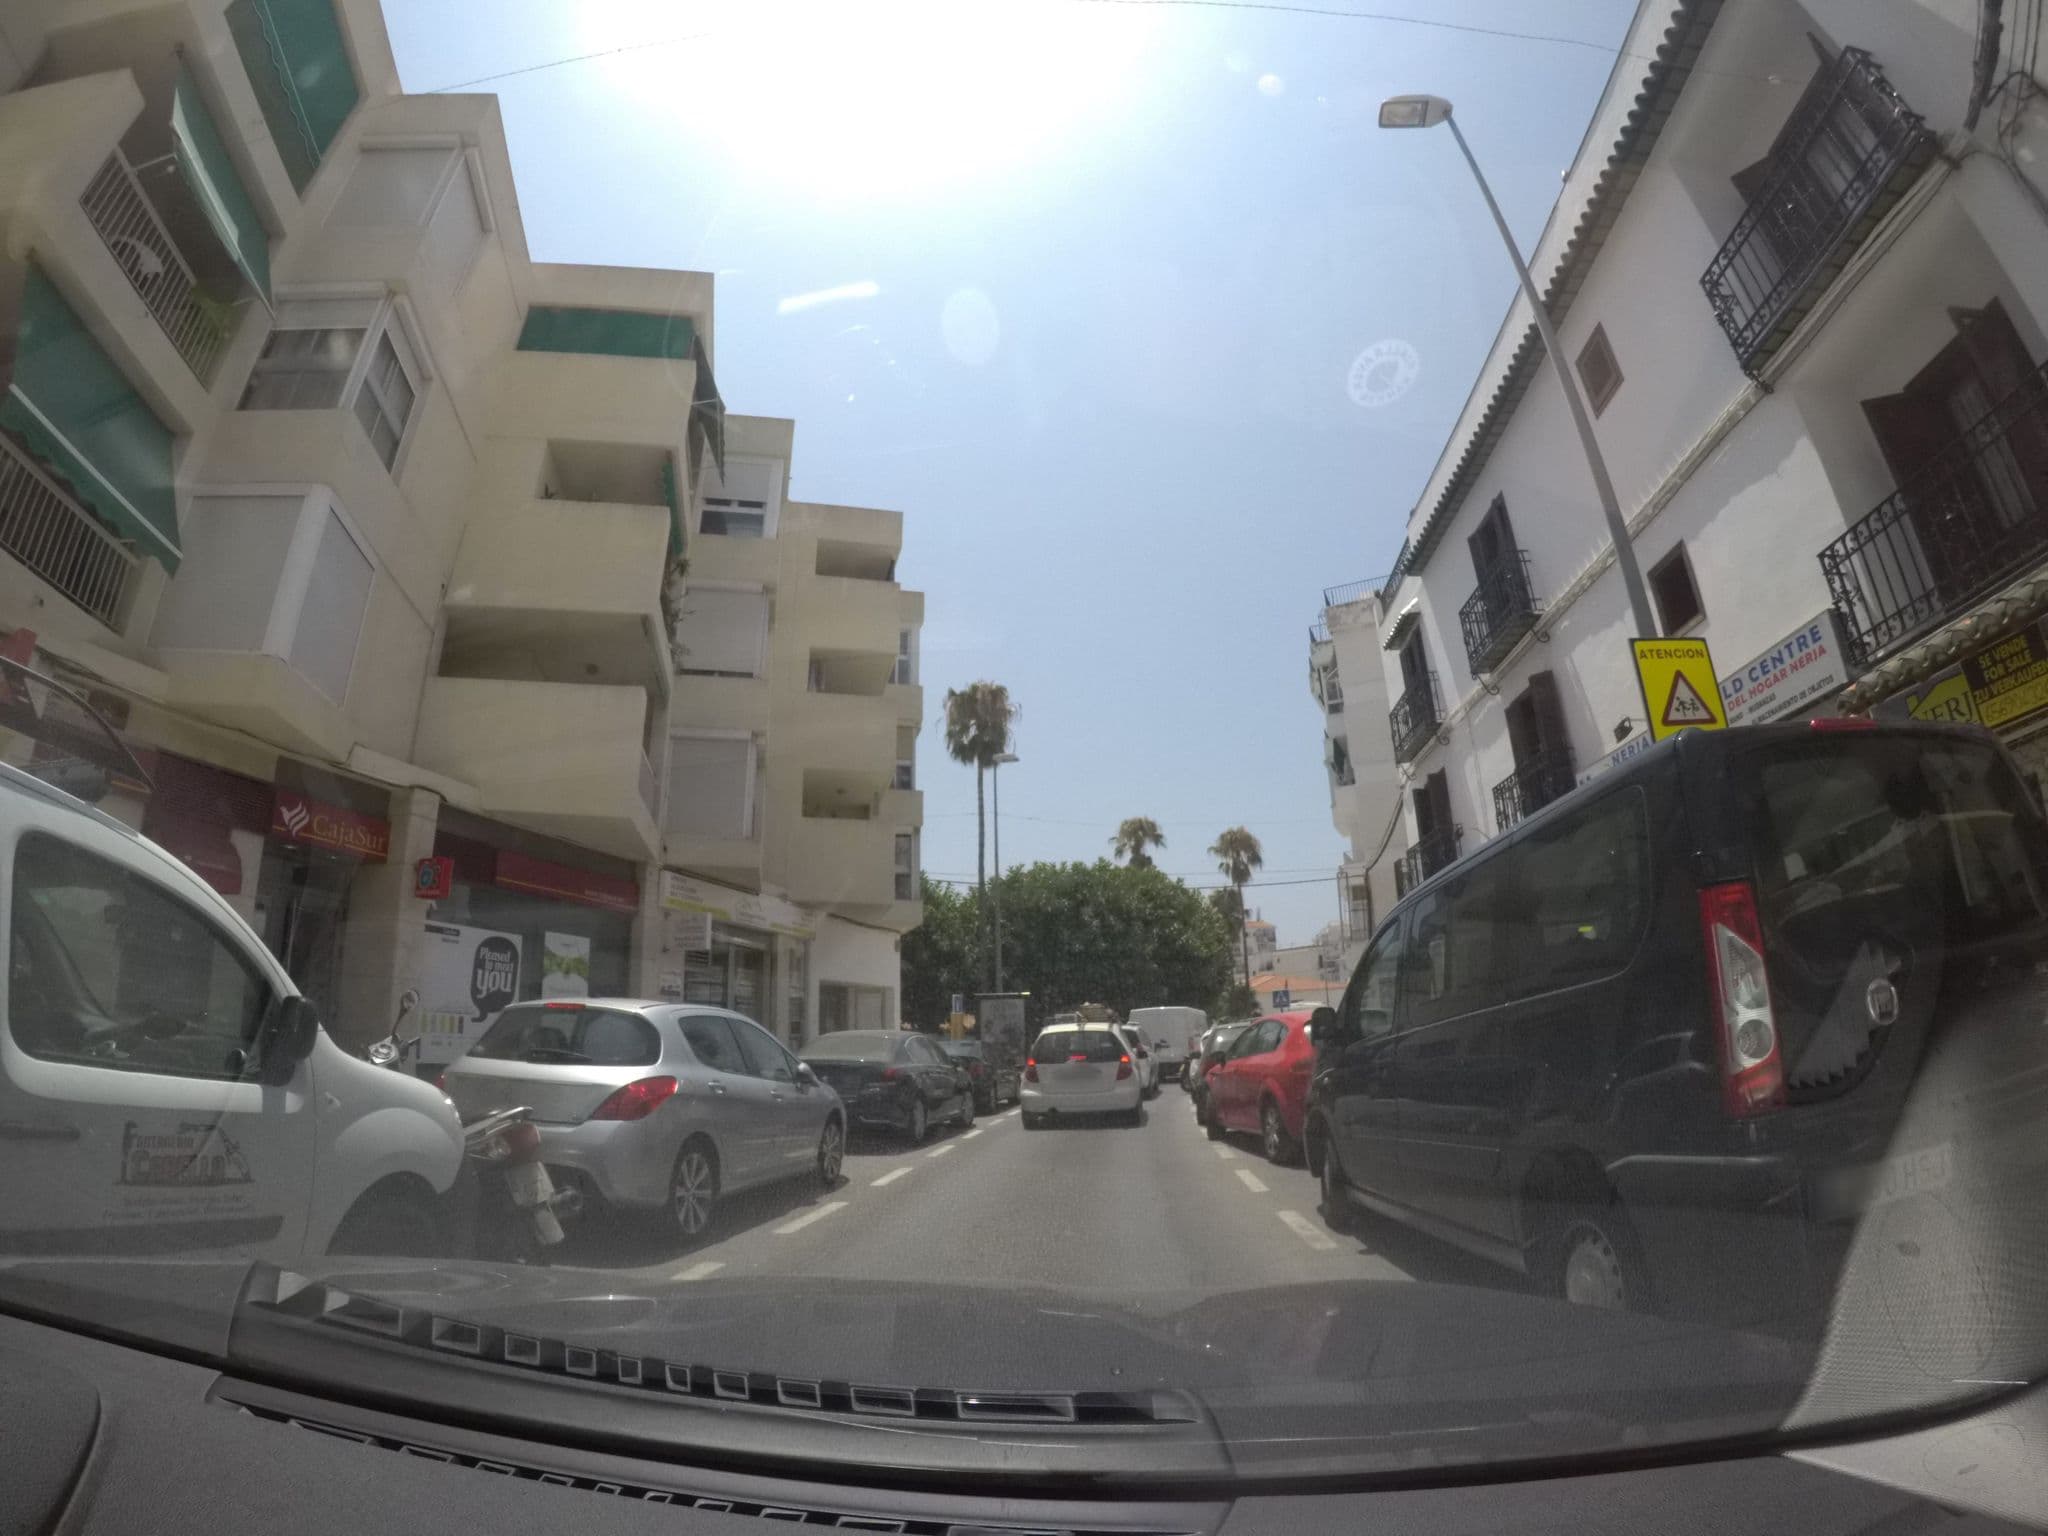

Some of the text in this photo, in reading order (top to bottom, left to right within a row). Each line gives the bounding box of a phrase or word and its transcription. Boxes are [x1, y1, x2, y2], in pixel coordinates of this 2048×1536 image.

[1640, 648, 1705, 659] ATENCION
[1748, 624, 1822, 682] CENTRE
[1983, 662, 2006, 683] FOR
[1727, 694, 1748, 712] DEL
[1748, 669, 1789, 699] HOGAR
[480, 946, 511, 962] Pleased
[477, 969, 512, 999] you
